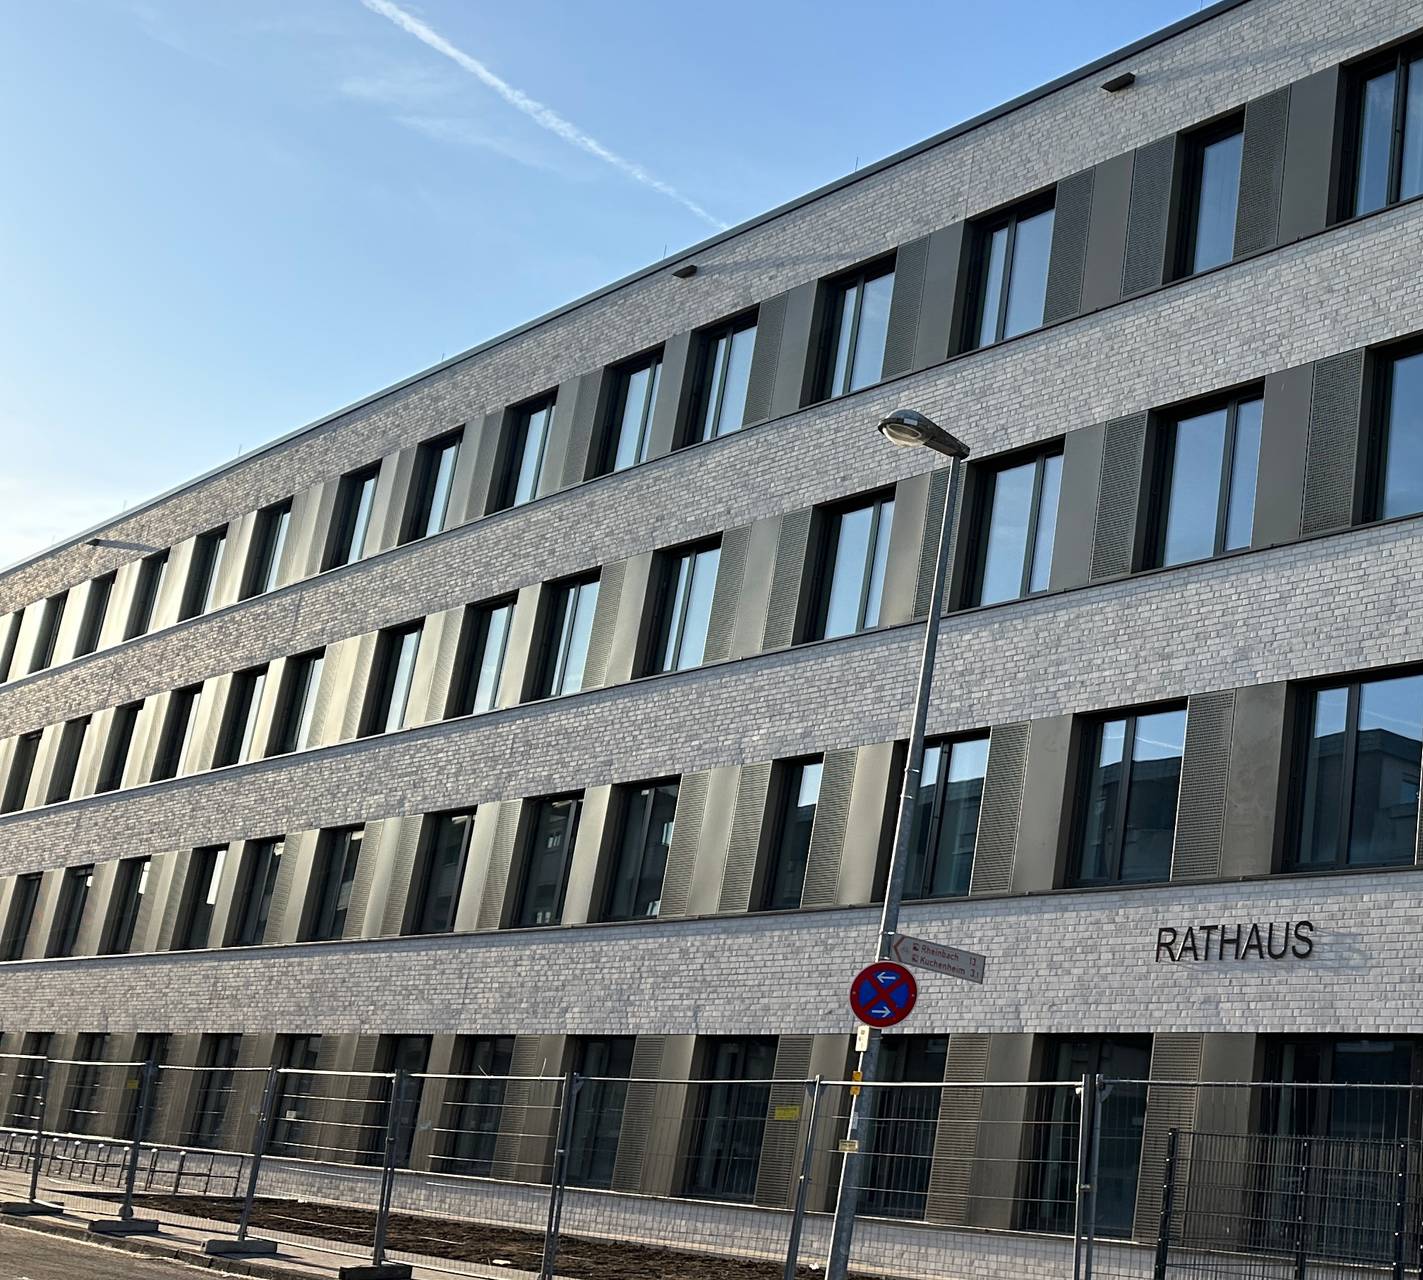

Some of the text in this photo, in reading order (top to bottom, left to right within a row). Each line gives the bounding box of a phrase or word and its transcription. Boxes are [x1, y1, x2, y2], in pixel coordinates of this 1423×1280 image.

[1155, 921, 1314, 962] RATHAUS
[921, 945, 959, 961] Rheinbach
[920, 956, 965, 975] Kuchenheim
